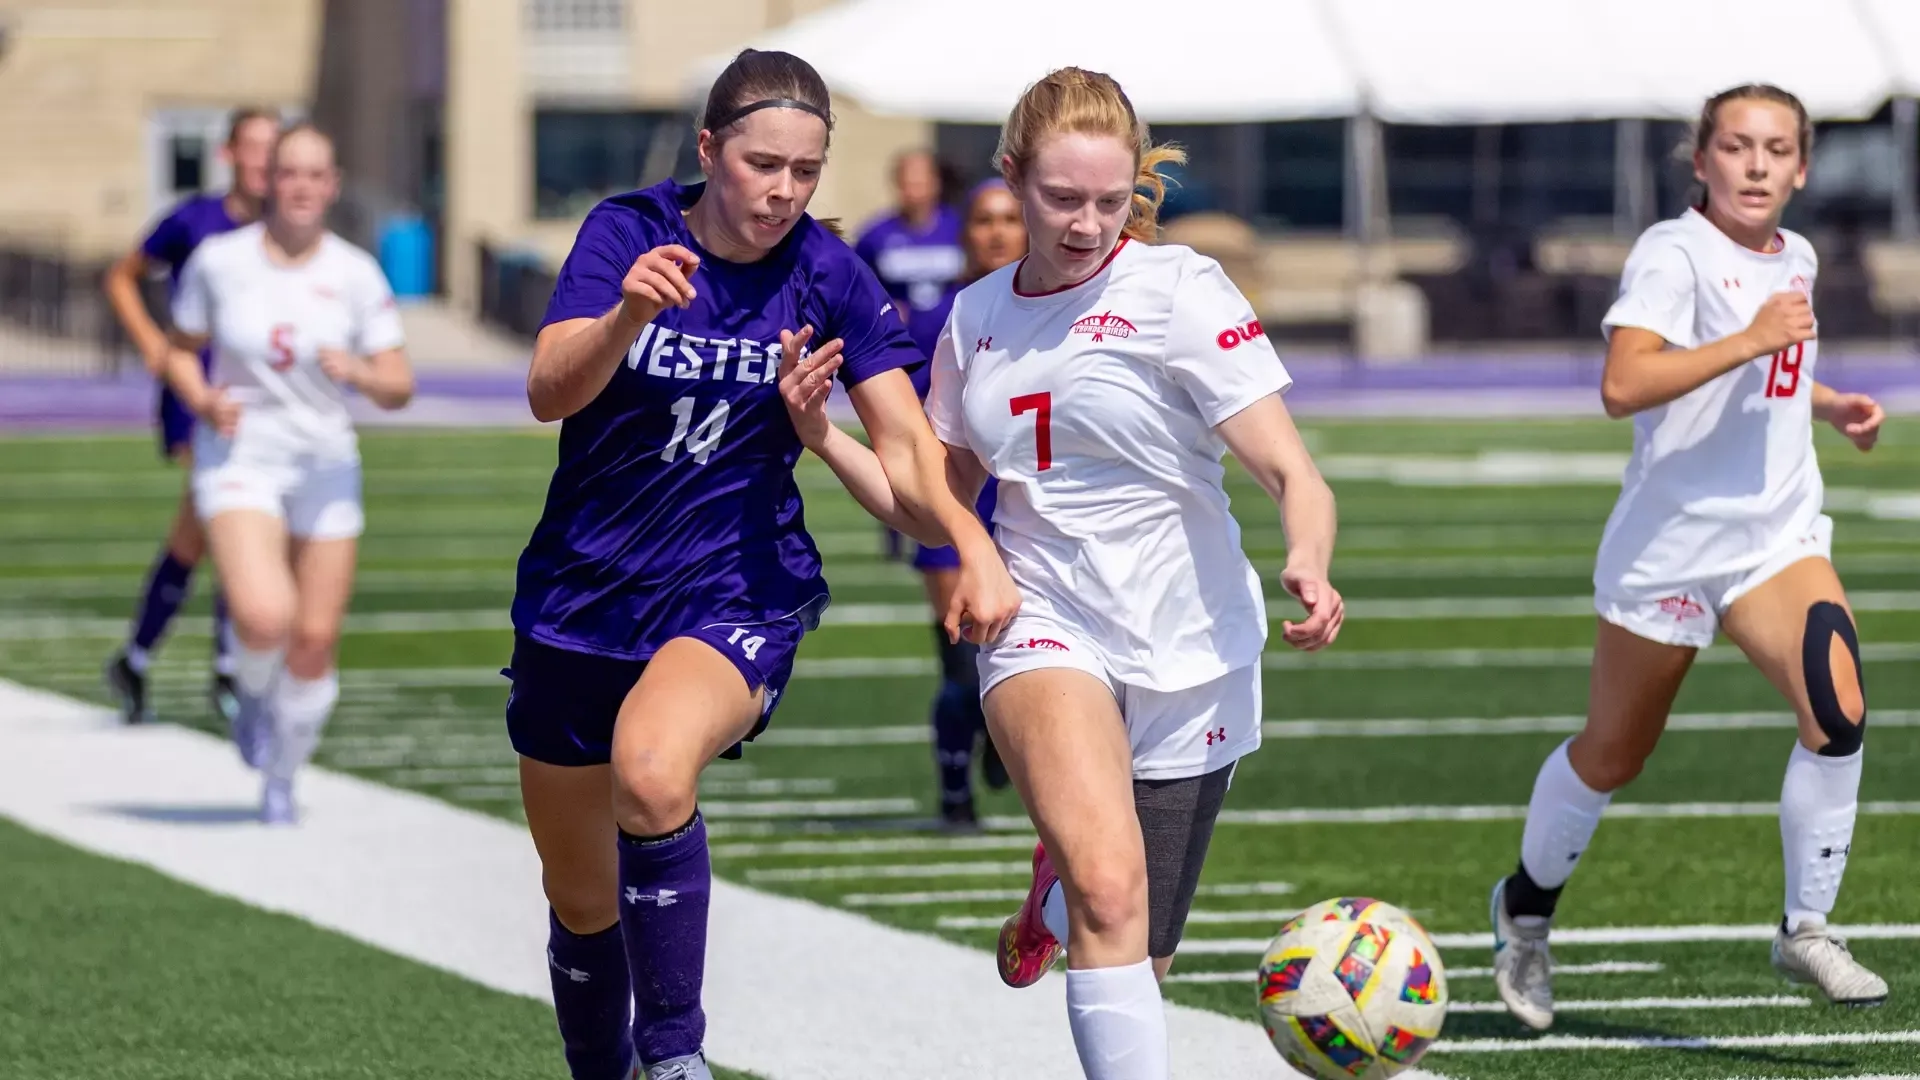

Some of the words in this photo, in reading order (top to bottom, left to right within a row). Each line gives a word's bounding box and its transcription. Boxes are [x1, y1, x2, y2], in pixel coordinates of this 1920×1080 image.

[628, 323, 812, 384] ESTER
[1074, 325, 1129, 338] THUNDERBIRDS
[1765, 340, 1804, 398] 19
[660, 396, 731, 466] 14
[1009, 391, 1052, 472] 7
[727, 627, 767, 661] 14
